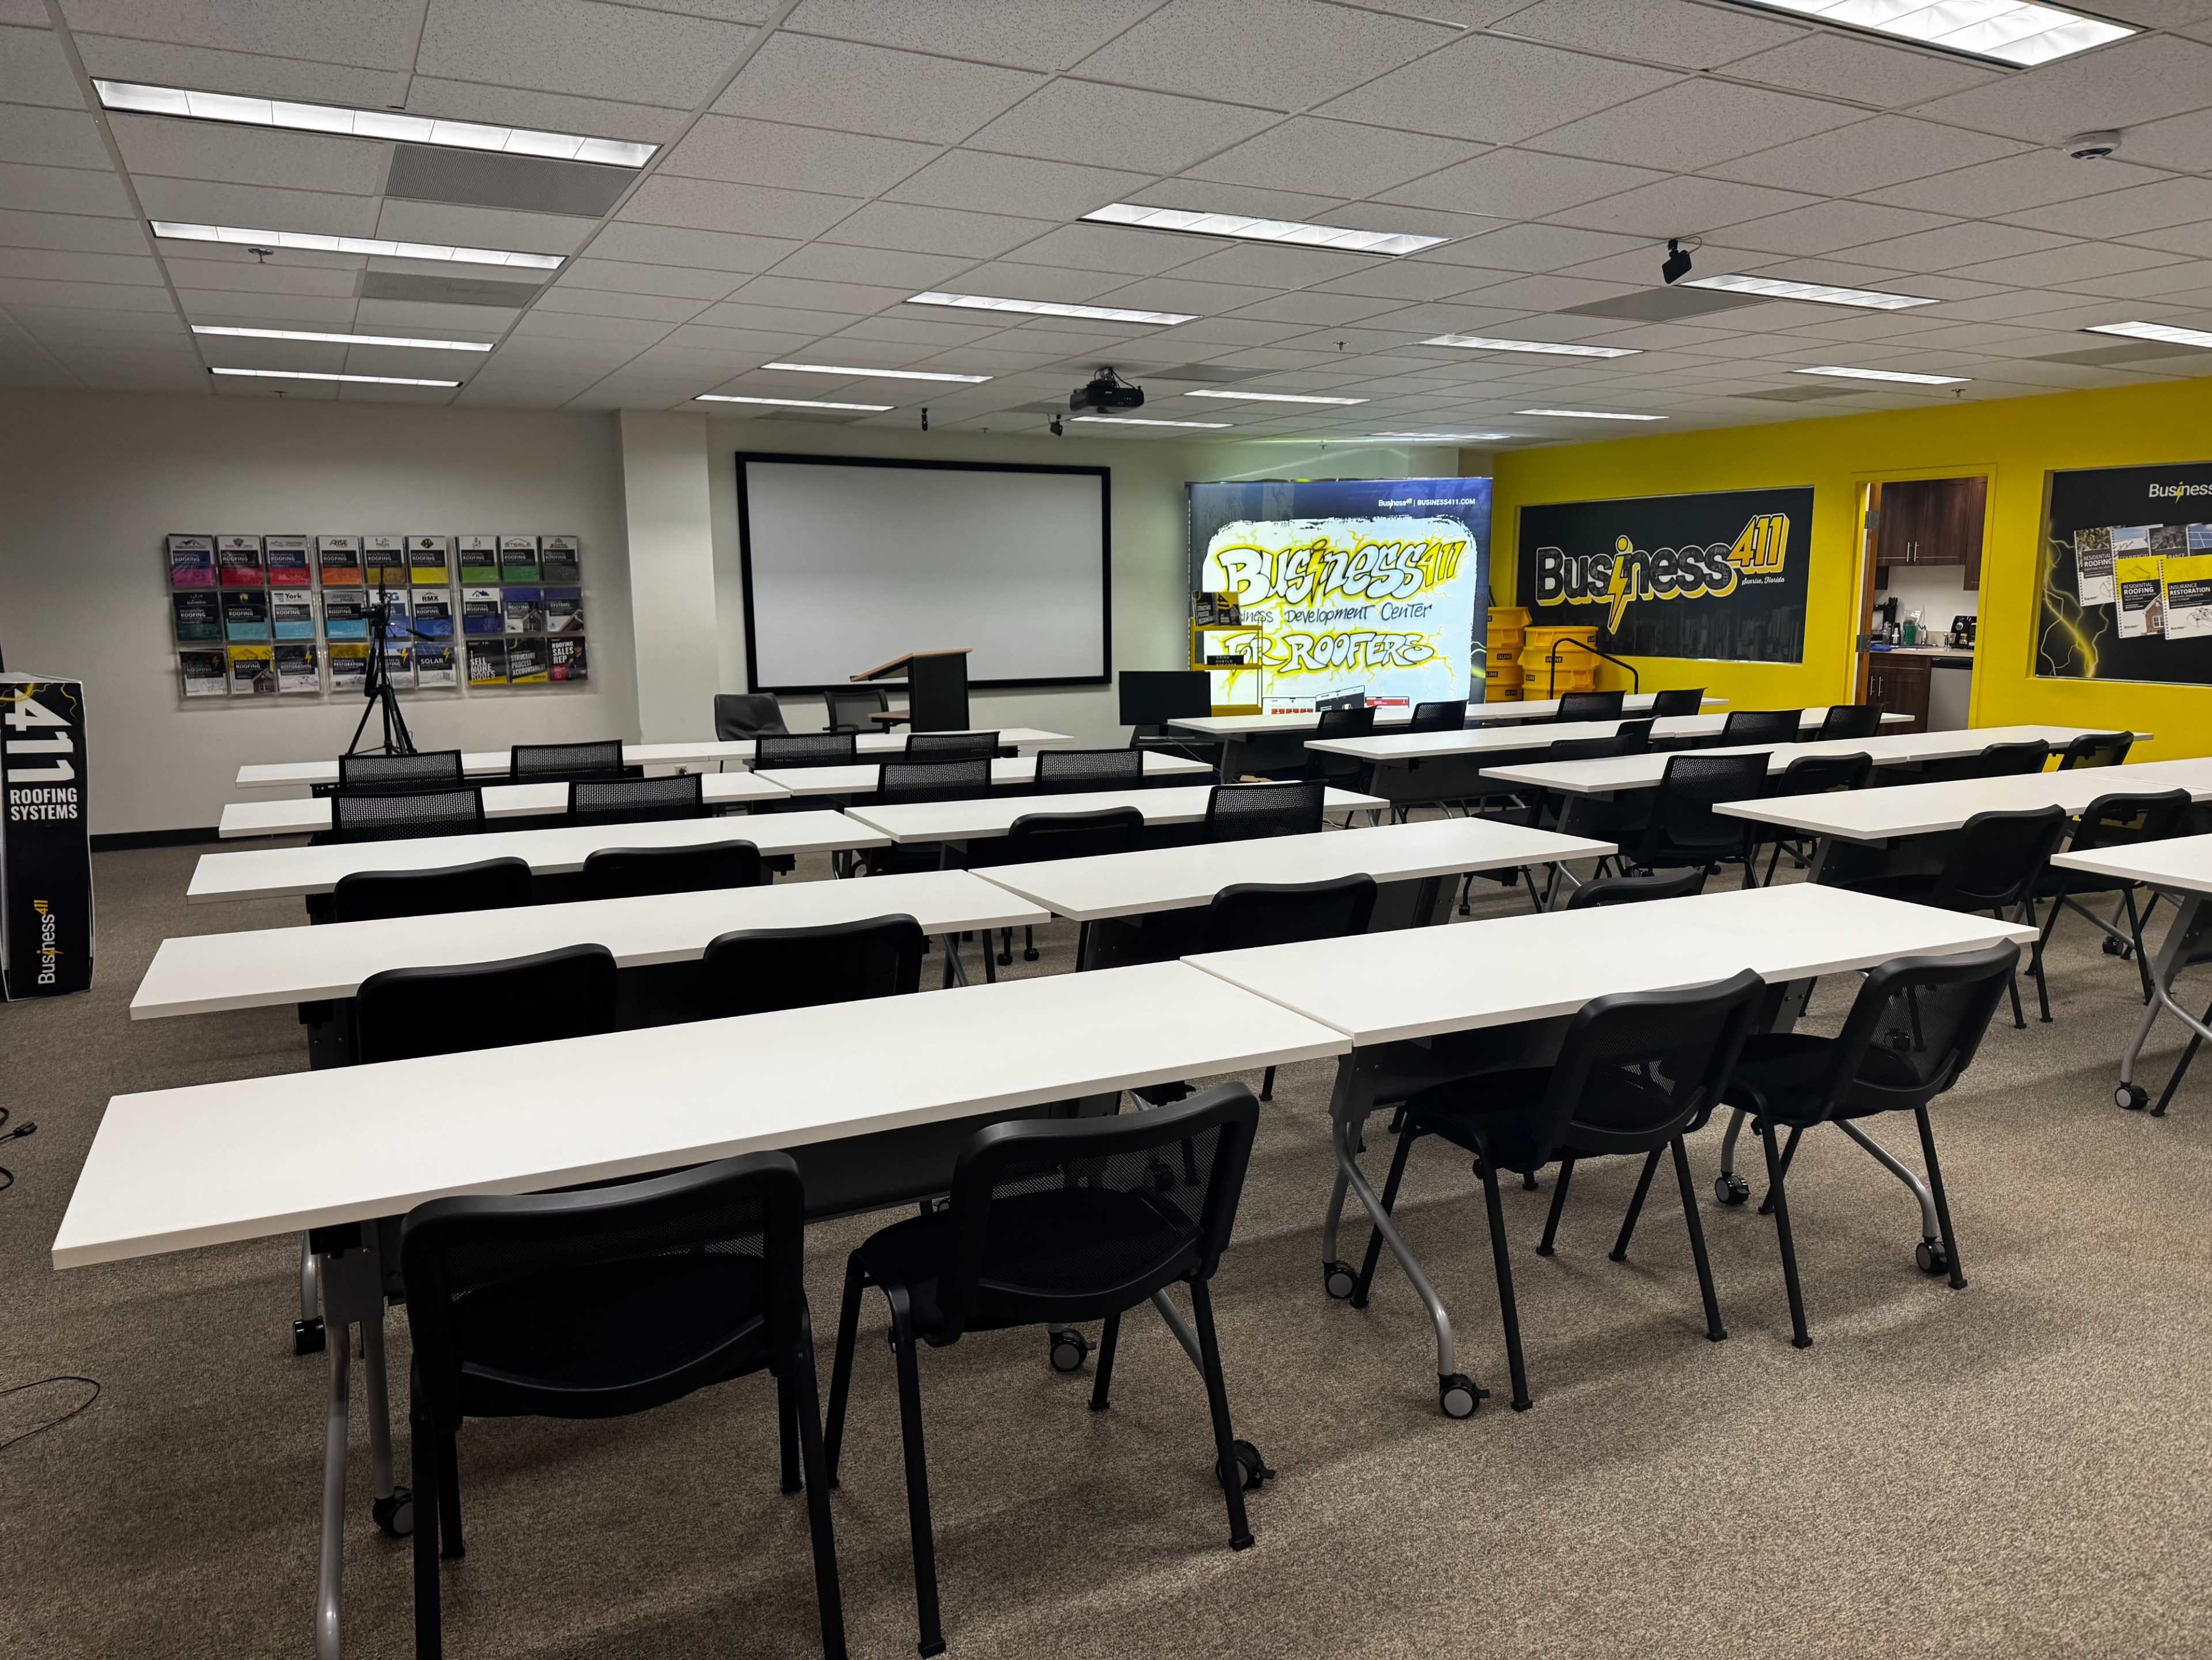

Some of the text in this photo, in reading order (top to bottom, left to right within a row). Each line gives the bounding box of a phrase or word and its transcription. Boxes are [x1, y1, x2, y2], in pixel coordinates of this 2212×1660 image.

[2084, 558, 2112, 567] ROOFING
[2170, 587, 2211, 596] RESTORATION
[1240, 602, 1432, 625] iness Development Center
[552, 641, 574, 649] ROOFING
[553, 646, 574, 656] SALES
[1278, 632, 1434, 673] ROOFERS
[470, 657, 487, 665] SELL
[511, 652, 535, 661] STRUCTURE
[554, 655, 567, 664] REP
[471, 663, 492, 674] MORE
[512, 660, 532, 669] PROCESS
[471, 670, 495, 681] ROOFS
[5, 688, 75, 782] 411
[10, 788, 78, 804] ROOFING
[10, 804, 78, 821] SYSTEMS
[34, 899, 65, 984] Business411
